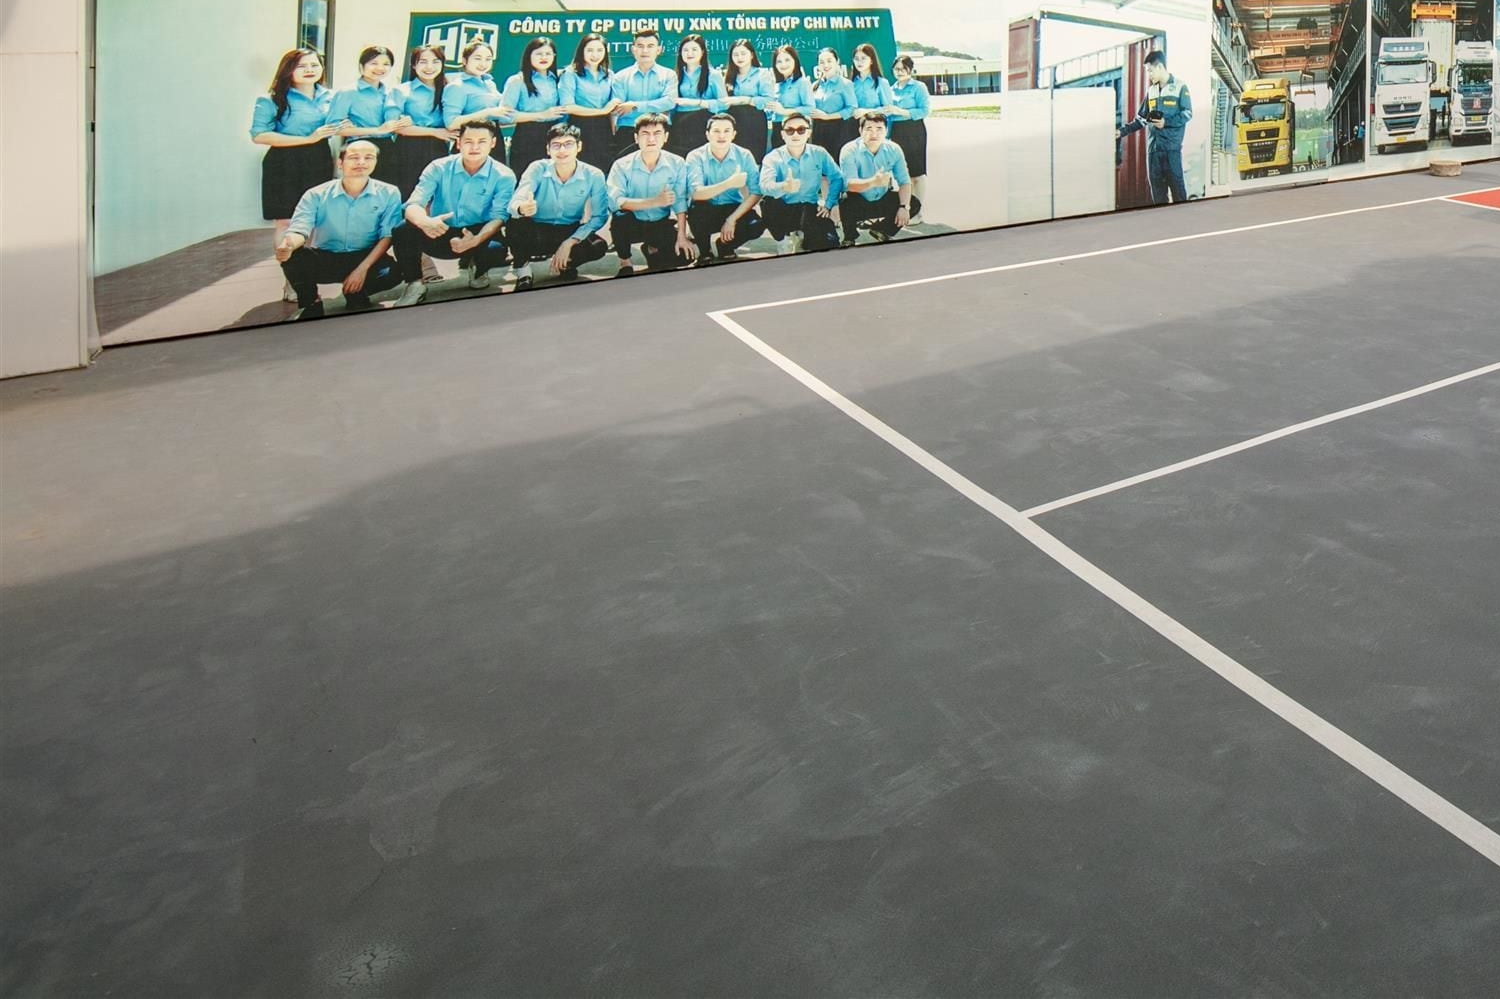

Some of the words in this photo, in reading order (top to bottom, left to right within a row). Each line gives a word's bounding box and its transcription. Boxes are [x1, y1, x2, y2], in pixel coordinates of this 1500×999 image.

[509, 16, 561, 34] CÔNG
[565, 19, 587, 33] TY
[591, 19, 615, 33] CP
[663, 18, 685, 34] VỤ
[689, 17, 722, 31] XNK
[770, 15, 800, 32] HỢP
[803, 16, 827, 29] CHI
[829, 16, 853, 29] MA
[855, 16, 880, 29] HTT
